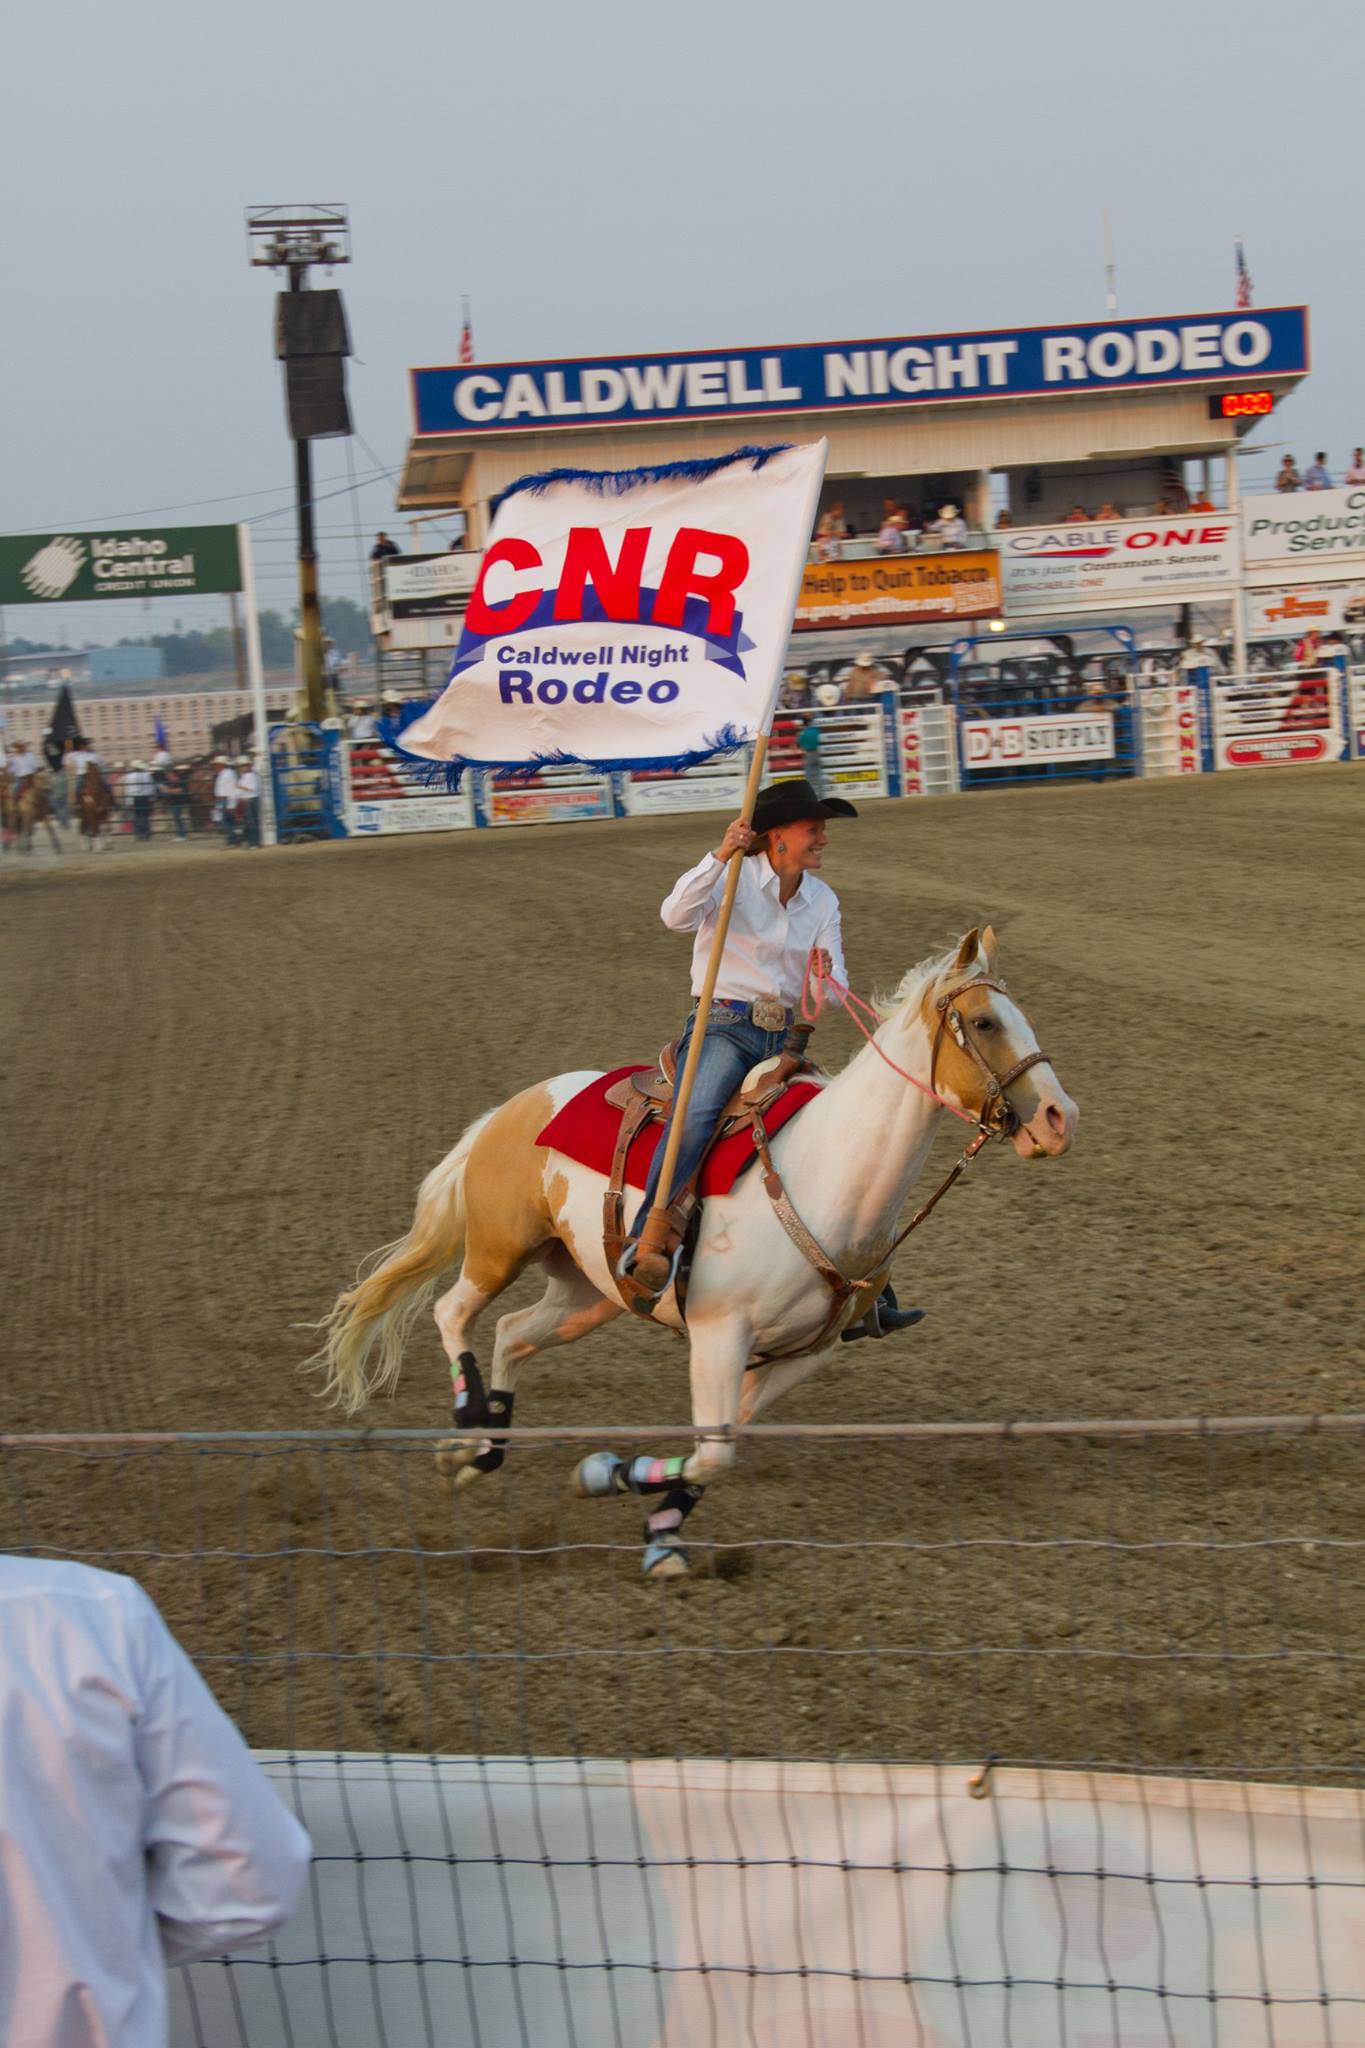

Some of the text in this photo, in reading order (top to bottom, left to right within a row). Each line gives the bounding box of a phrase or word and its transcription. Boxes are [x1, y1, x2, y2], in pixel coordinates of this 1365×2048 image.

[453, 320, 1271, 421] CALDWELL NIGHT RODEO
[1250, 515, 1365, 536] Produc
[91, 537, 168, 557] Idaho
[1008, 526, 1232, 550] CABLE ONE
[92, 554, 195, 578] Central
[1080, 558, 1163, 572] Common
[1167, 554, 1221, 565] Sense
[465, 527, 749, 637] CNR
[804, 566, 990, 598] Help to Quit Tobacco
[497, 645, 689, 667] Caldwell Night
[498, 670, 680, 704] Rodeo
[1027, 727, 1108, 751] SUPPLY
